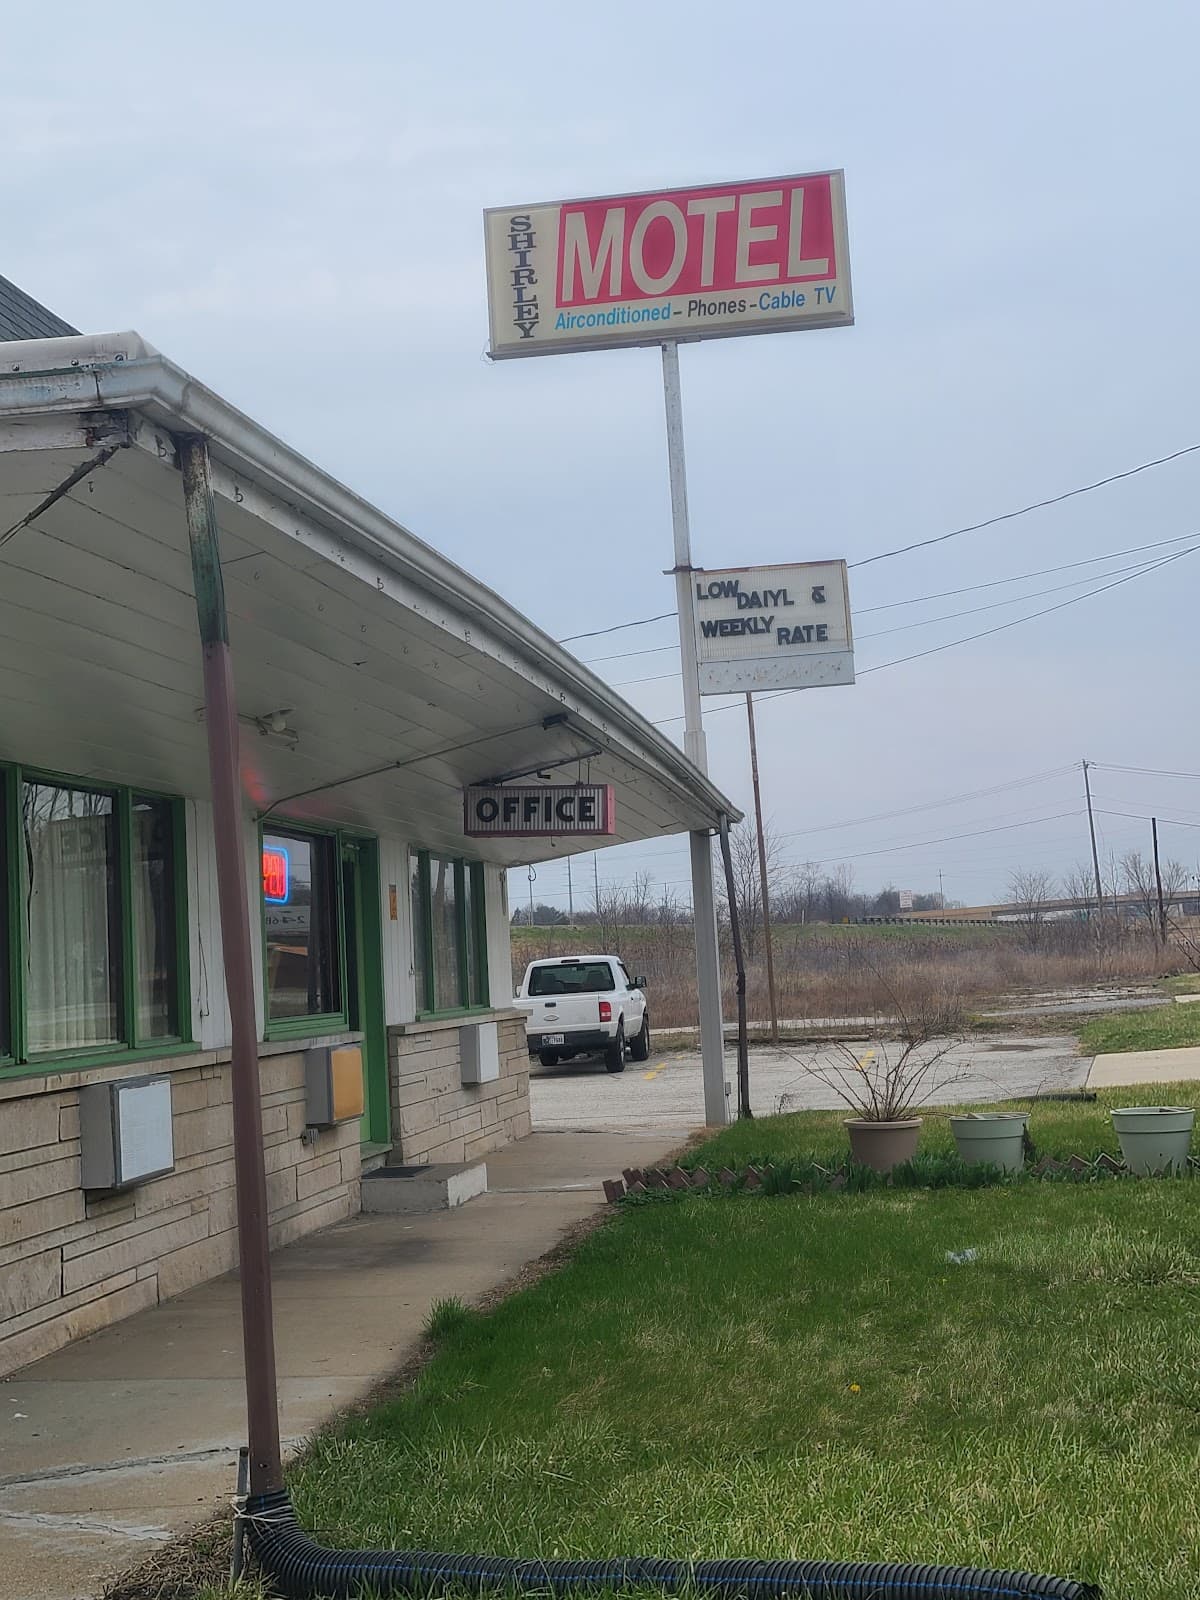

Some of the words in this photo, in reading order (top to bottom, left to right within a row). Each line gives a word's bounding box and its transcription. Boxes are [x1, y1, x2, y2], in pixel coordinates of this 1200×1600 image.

[561, 187, 830, 303] MOTEL
[507, 215, 539, 339] SHIRLEY
[554, 303, 671, 331] Airconditioned
[687, 298, 747, 318] Phones
[758, 289, 806, 311] Cable
[814, 286, 836, 306] TV
[696, 580, 740, 600] LOW
[736, 589, 795, 610] DAIYL
[811, 586, 826, 604] &
[700, 616, 775, 639] WEEKLY
[777, 624, 829, 646] RATE
[476, 796, 596, 823] OFFICE
